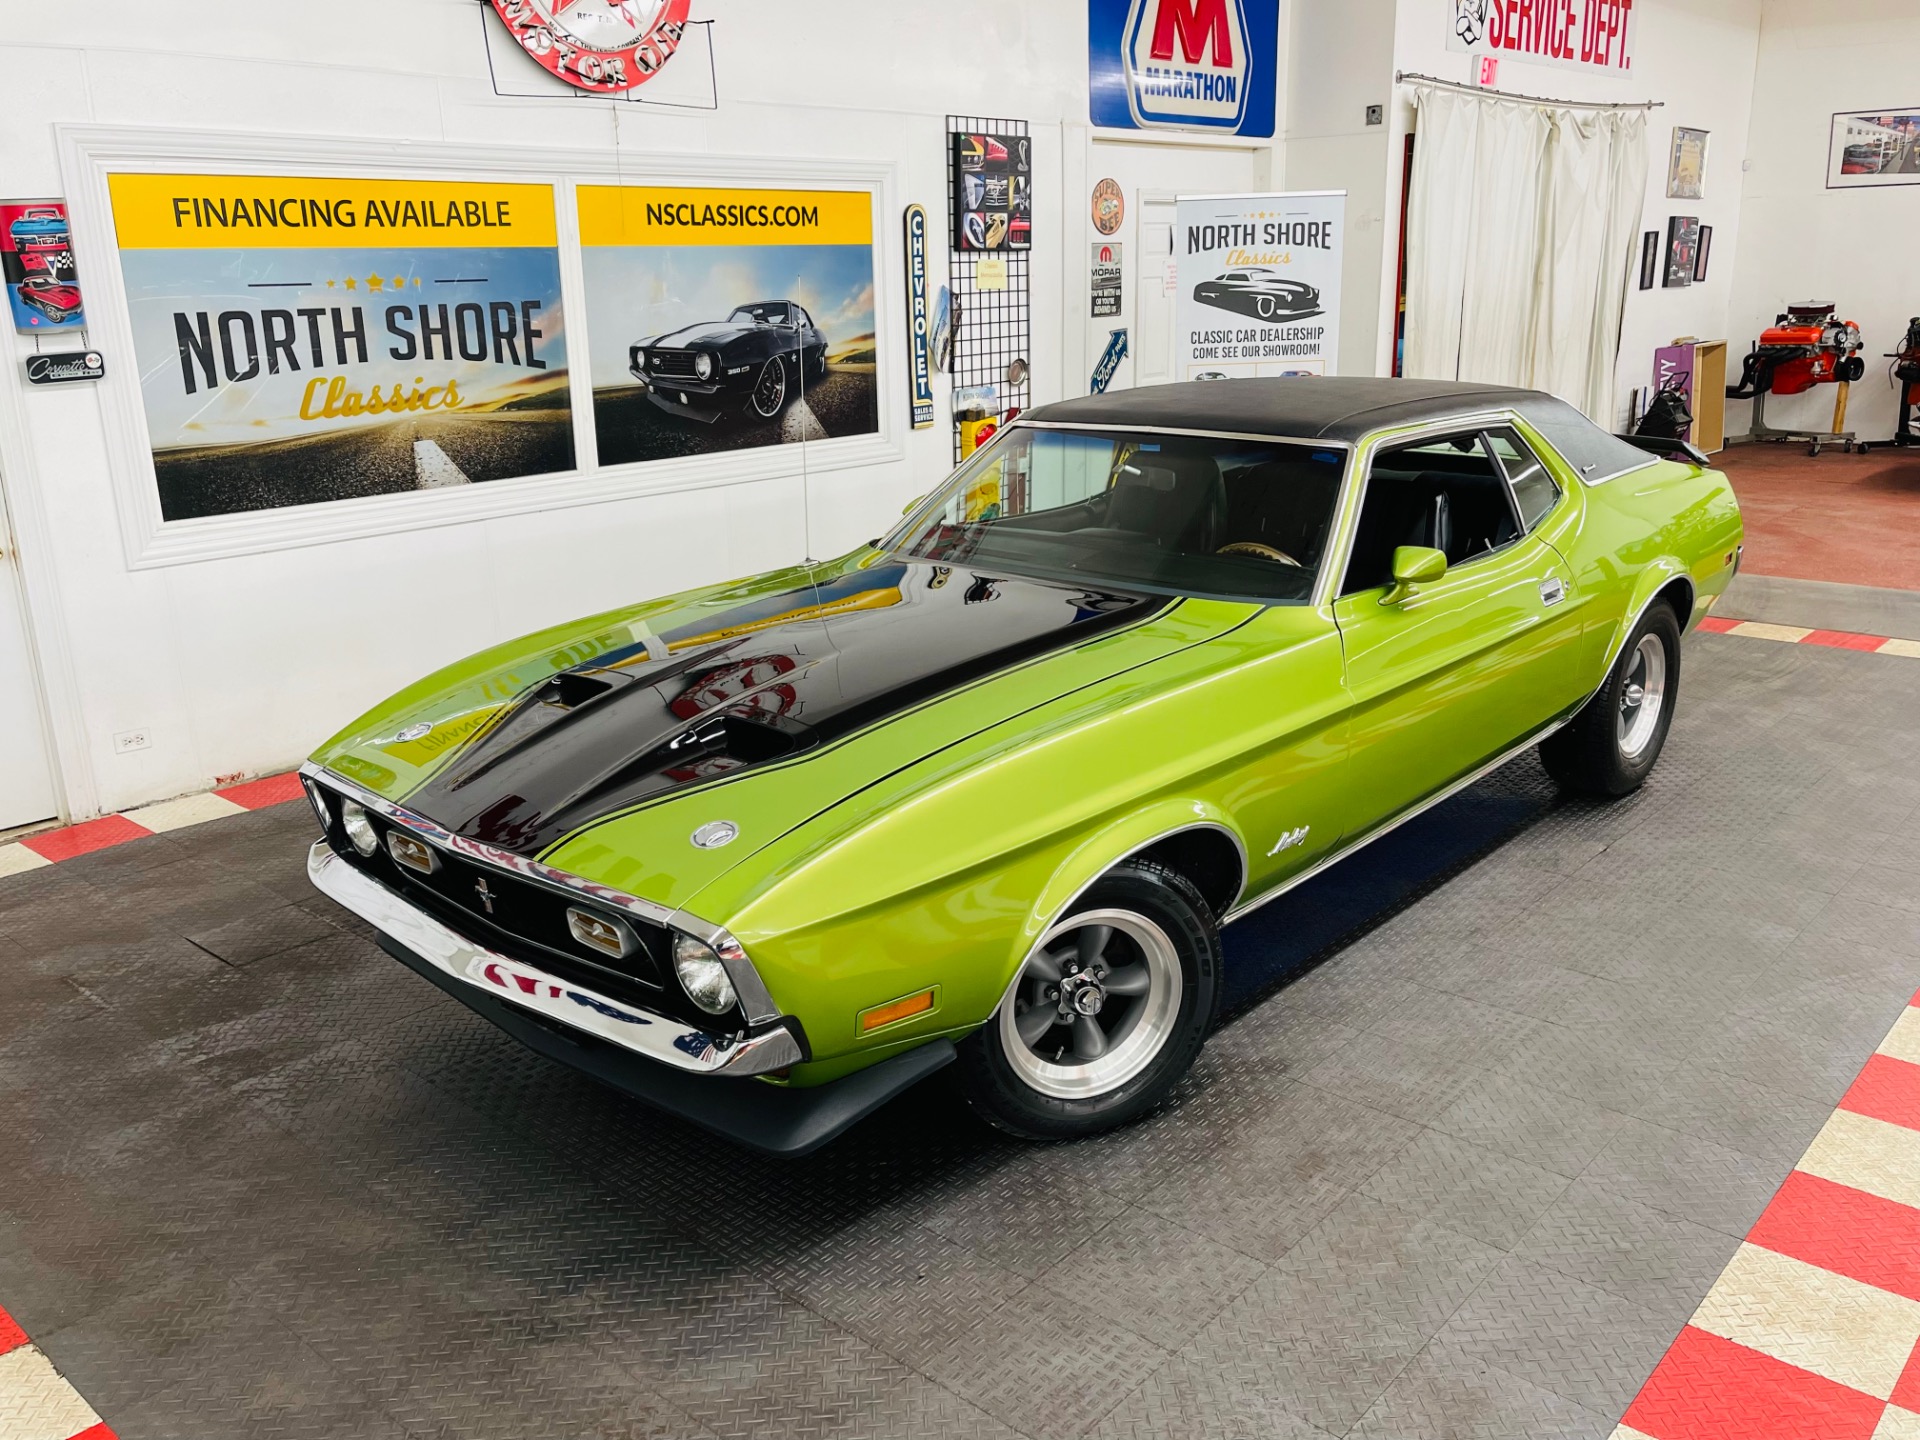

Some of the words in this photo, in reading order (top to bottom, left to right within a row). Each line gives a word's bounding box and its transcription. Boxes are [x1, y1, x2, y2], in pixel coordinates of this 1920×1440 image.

[500, 0, 629, 88] MOTOR
[634, 19, 686, 75] OIL
[1489, 0, 1576, 60] SERVICE
[1581, 0, 1632, 70] DEPT.
[1144, 67, 1237, 103] MARATHON
[172, 197, 356, 227] FINANCING
[364, 199, 512, 227] AVAILABLE
[646, 203, 819, 227] NSCLASSICS.COM
[1099, 211, 1120, 231] BEE
[1187, 223, 1256, 255] NORTH
[1263, 221, 1332, 250] SHORE
[1091, 268, 1121, 276] MOPAR
[1225, 249, 1292, 266] Classics
[911, 216, 928, 396] CHEVROLET
[173, 306, 369, 395] NORTH
[385, 300, 547, 370] SHORE
[1190, 330, 1233, 345] CLASSIC
[1236, 329, 1257, 343] CAR
[1260, 327, 1324, 342] DEALERSHIP
[1192, 347, 1219, 360] COME
[1222, 346, 1239, 358] SEE
[1241, 345, 1260, 357] OUR
[1263, 343, 1320, 357] SHOWROOM!
[29, 358, 88, 380] Corvette
[1097, 349, 1117, 390] Ford
[299, 375, 465, 421] Classics
